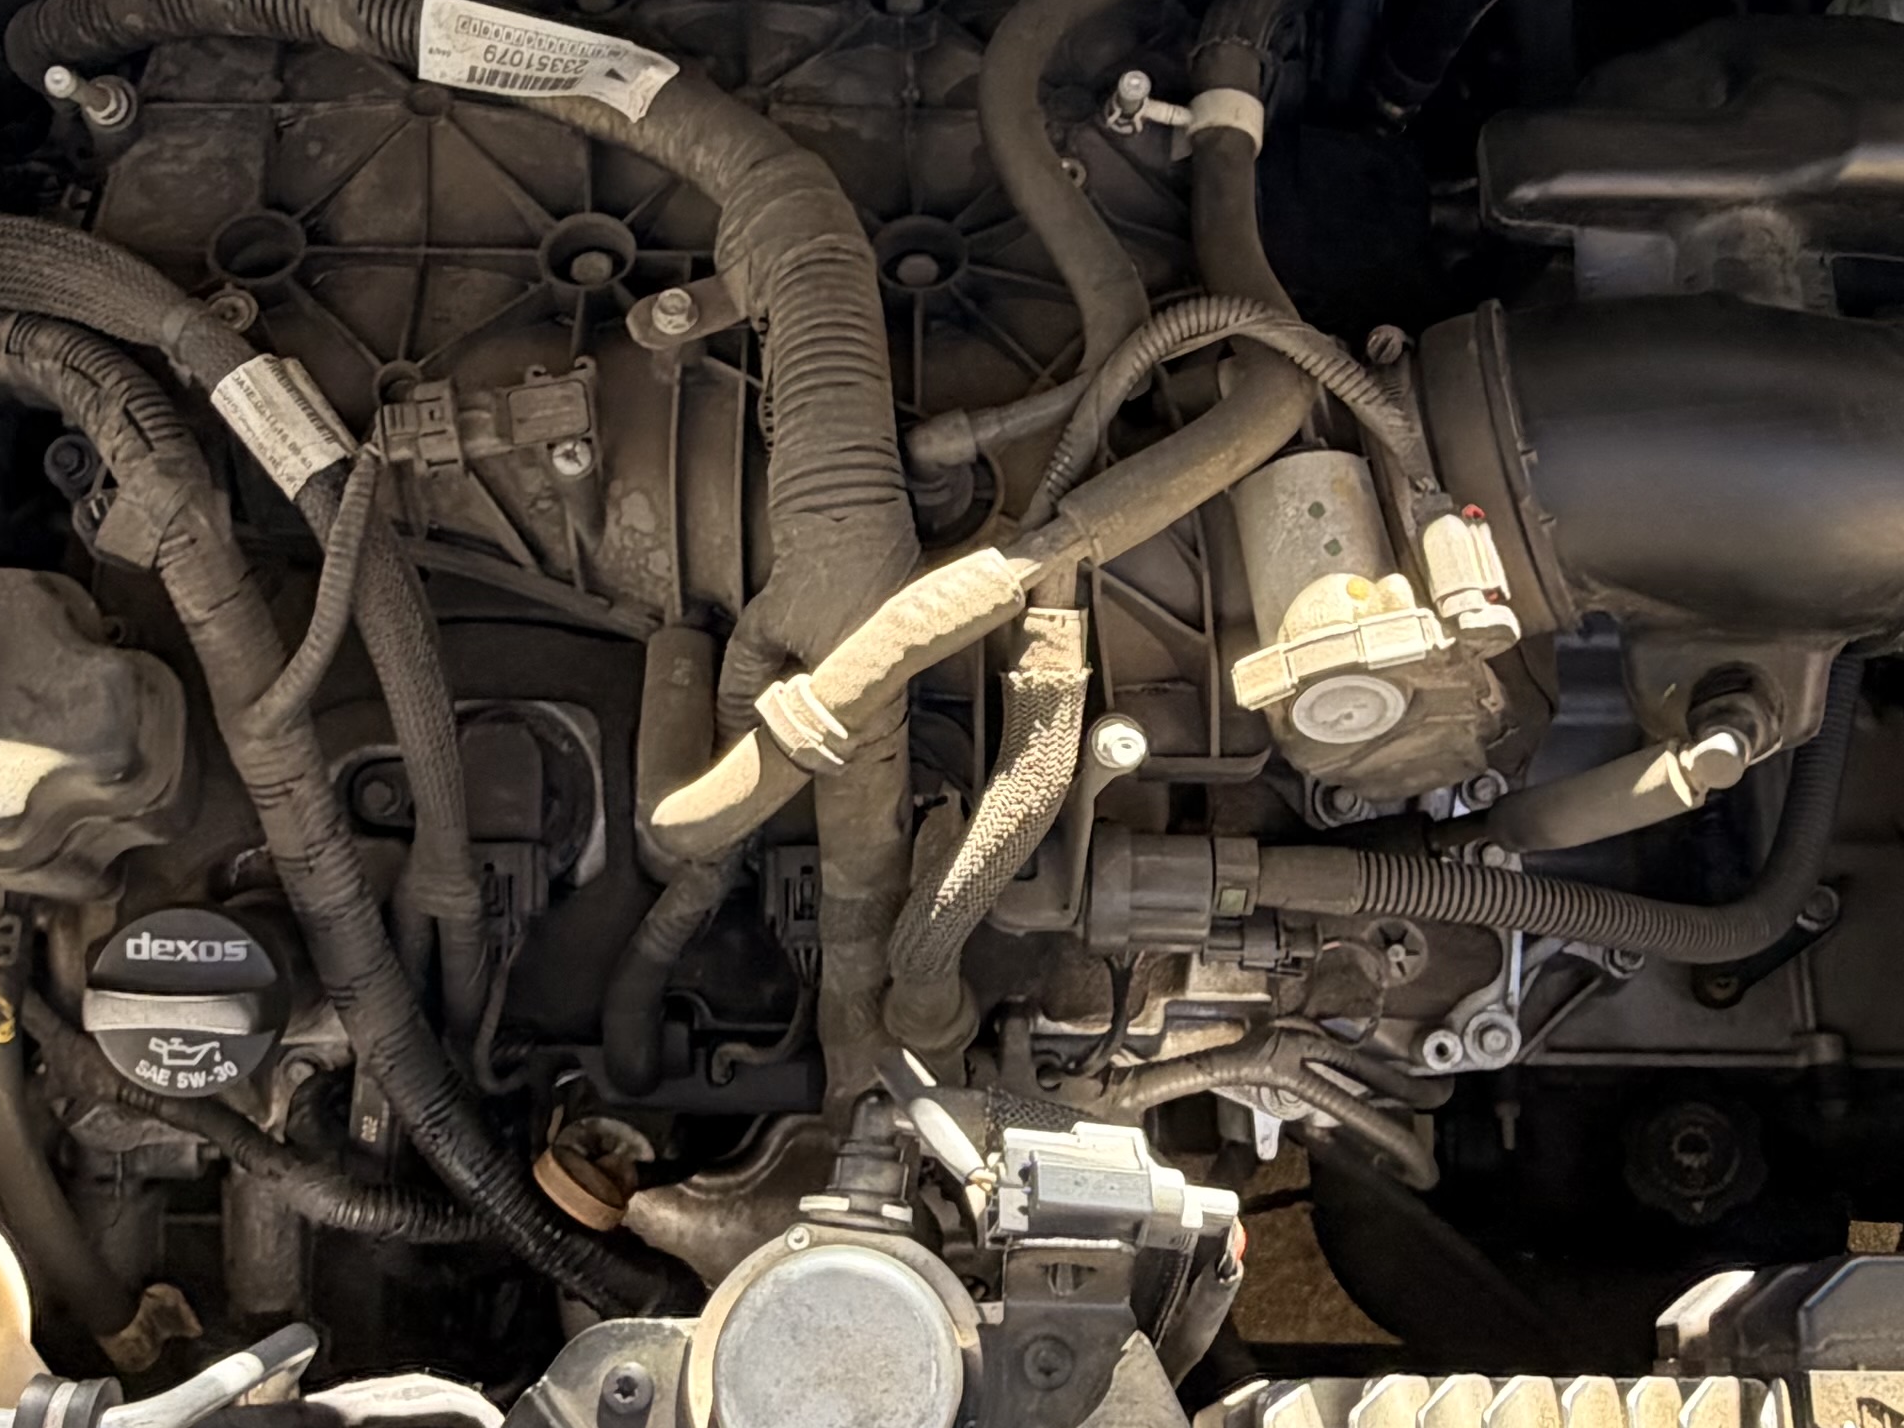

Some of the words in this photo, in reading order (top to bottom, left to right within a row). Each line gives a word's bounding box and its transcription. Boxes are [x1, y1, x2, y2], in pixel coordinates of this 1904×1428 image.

[483, 45, 590, 74] 23351079
[126, 932, 251, 963] dexos
[134, 1059, 172, 1086] SAE
[176, 1061, 238, 1089] 5W-30
